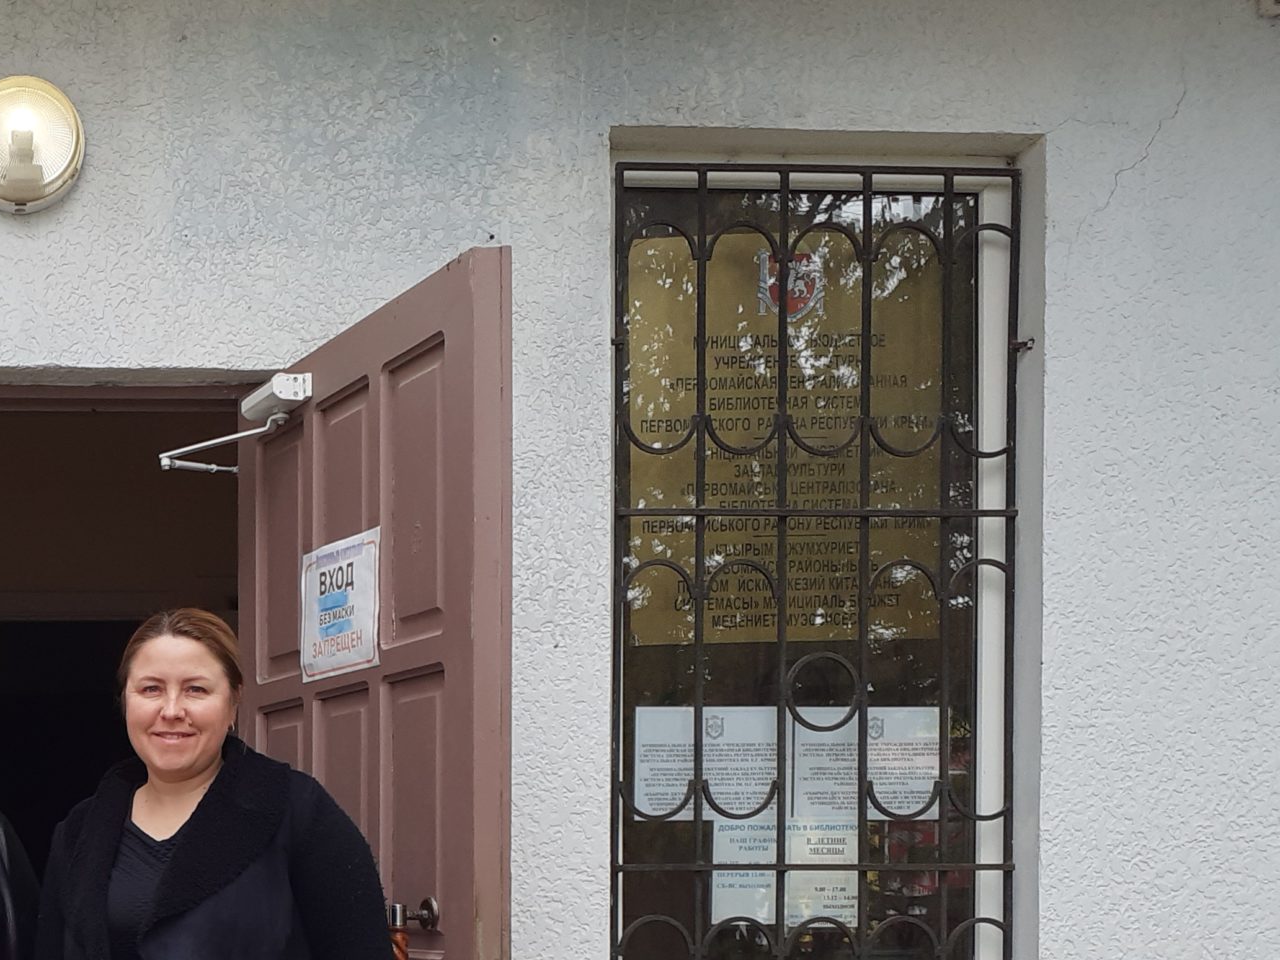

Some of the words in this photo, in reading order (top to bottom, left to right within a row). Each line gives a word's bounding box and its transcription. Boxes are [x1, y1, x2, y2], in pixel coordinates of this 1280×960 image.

[764, 517, 813, 534] РАОНУ
[319, 562, 355, 597] ВХОД
[319, 613, 333, 627] БЕЗ
[332, 604, 355, 622] МАСКИ
[312, 628, 363, 660] ЗАПРЕЩЕН
